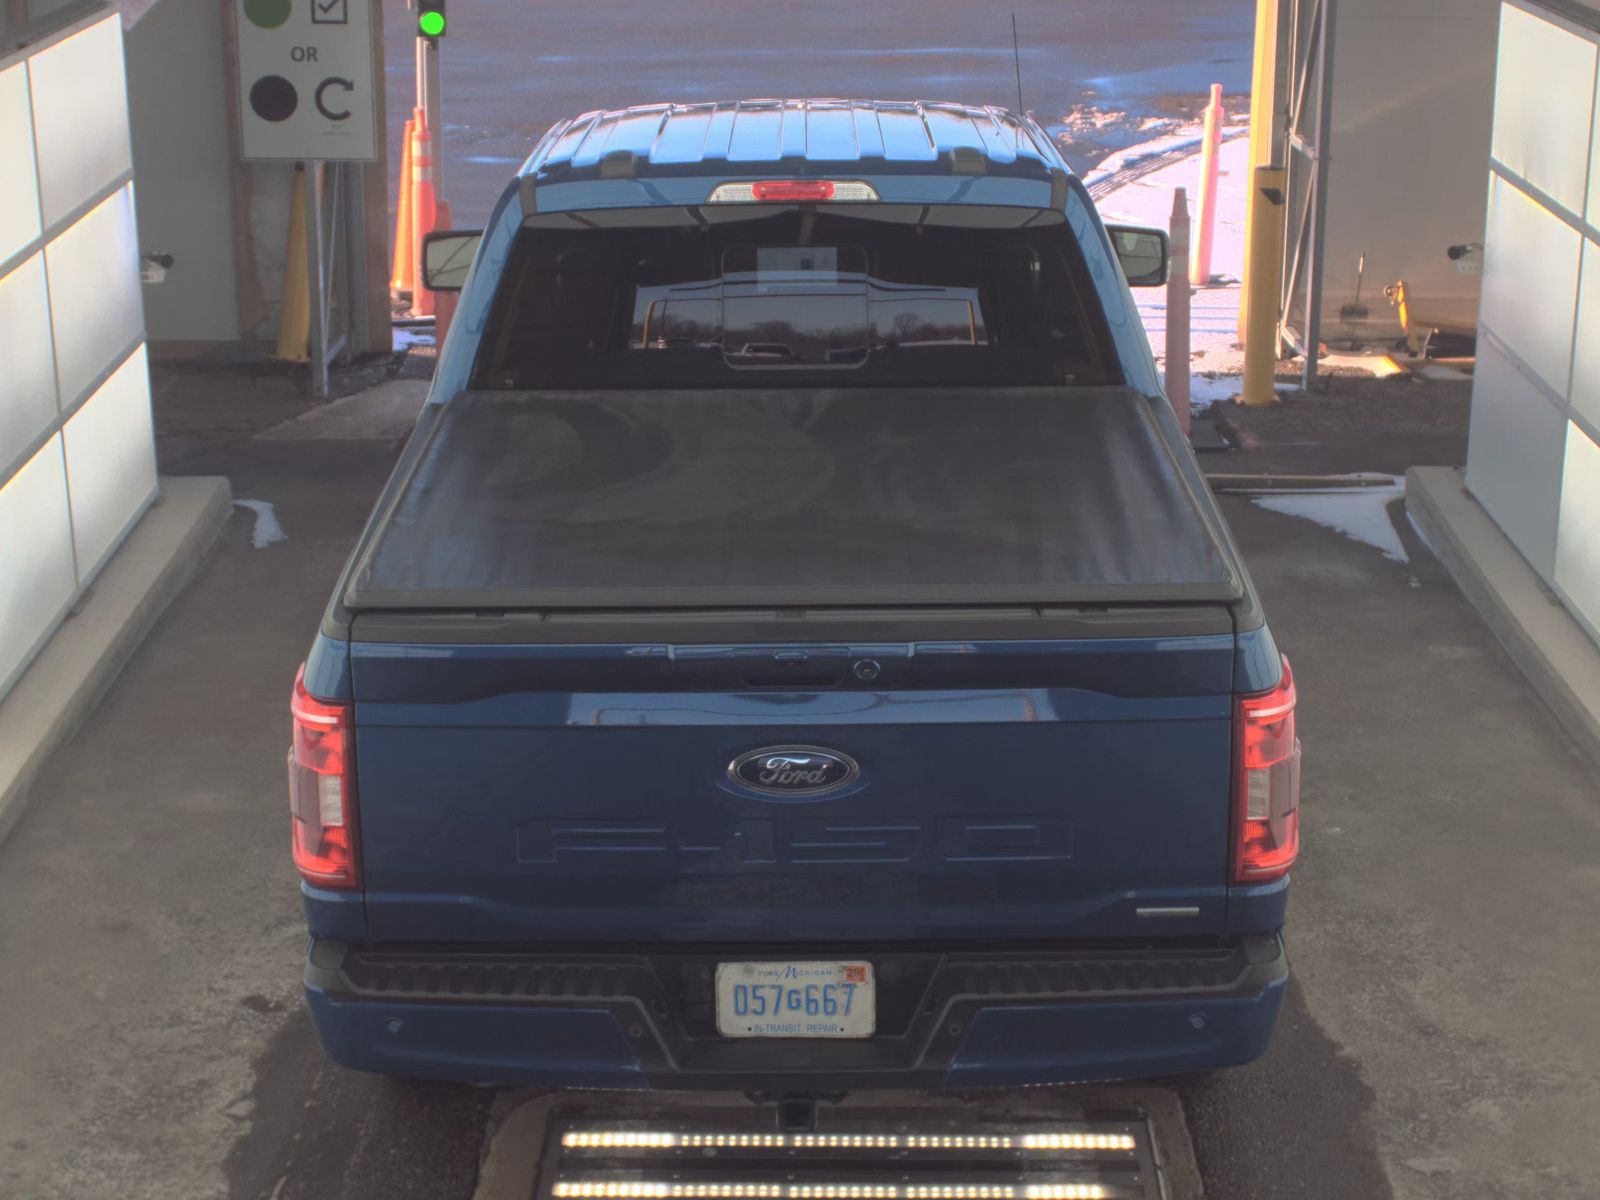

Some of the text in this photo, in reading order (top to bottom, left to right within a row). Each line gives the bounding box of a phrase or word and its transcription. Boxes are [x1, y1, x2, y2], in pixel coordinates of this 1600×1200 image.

[291, 46, 318, 62] OR
[759, 757, 827, 785] Ford
[515, 816, 1074, 864] F-150
[780, 965, 832, 980] MICHIGAN
[734, 983, 857, 1017] 057G667
[753, 1023, 838, 1033] IN-TRANSIT REPAIR
